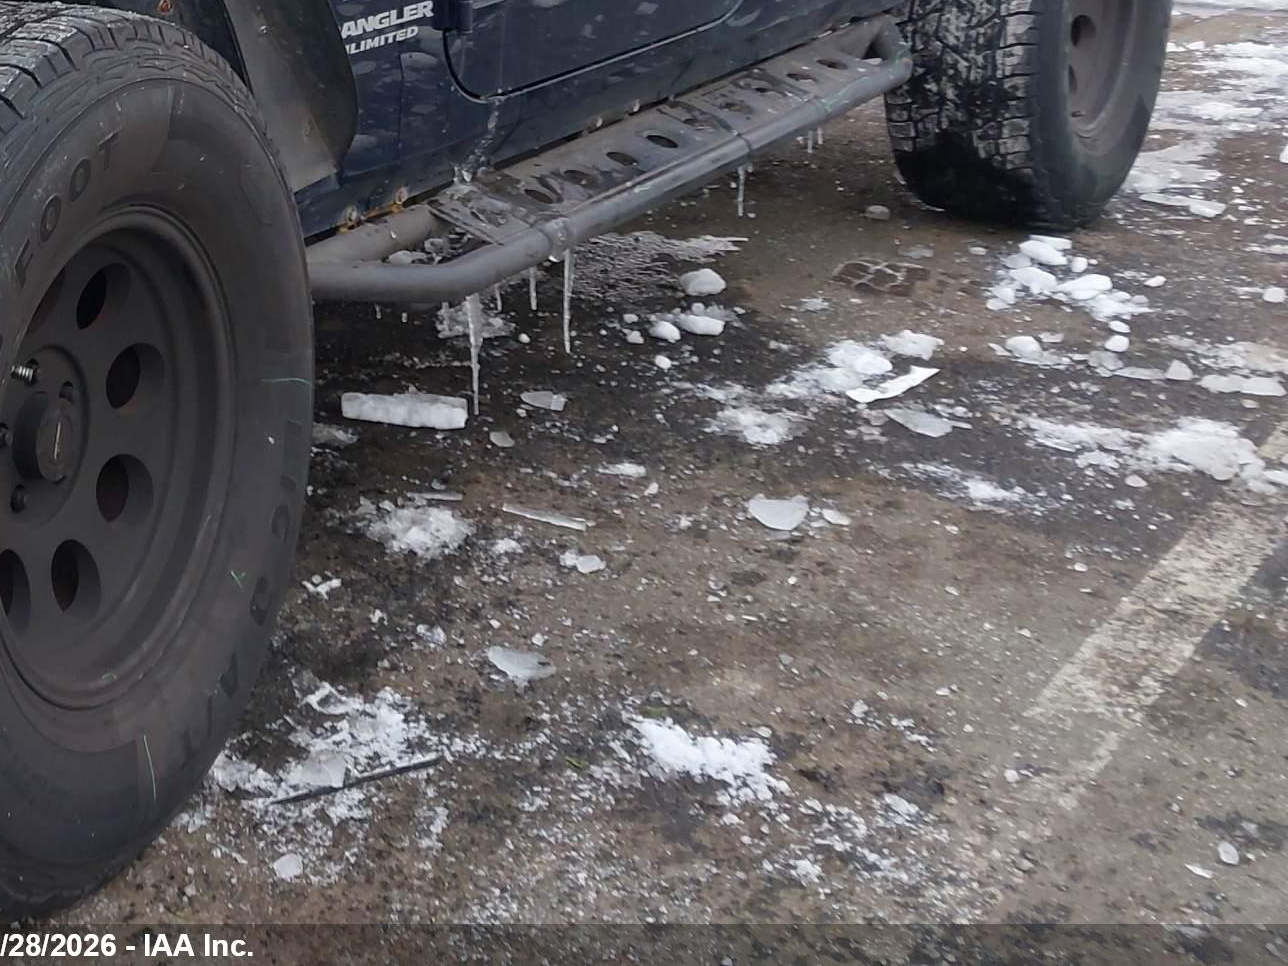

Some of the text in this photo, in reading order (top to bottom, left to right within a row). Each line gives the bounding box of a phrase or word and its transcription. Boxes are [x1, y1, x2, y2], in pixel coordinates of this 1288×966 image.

[338, 0, 435, 40] ANGLER
[344, 25, 419, 55] LIMITED
[14, 131, 119, 291] FOOT
